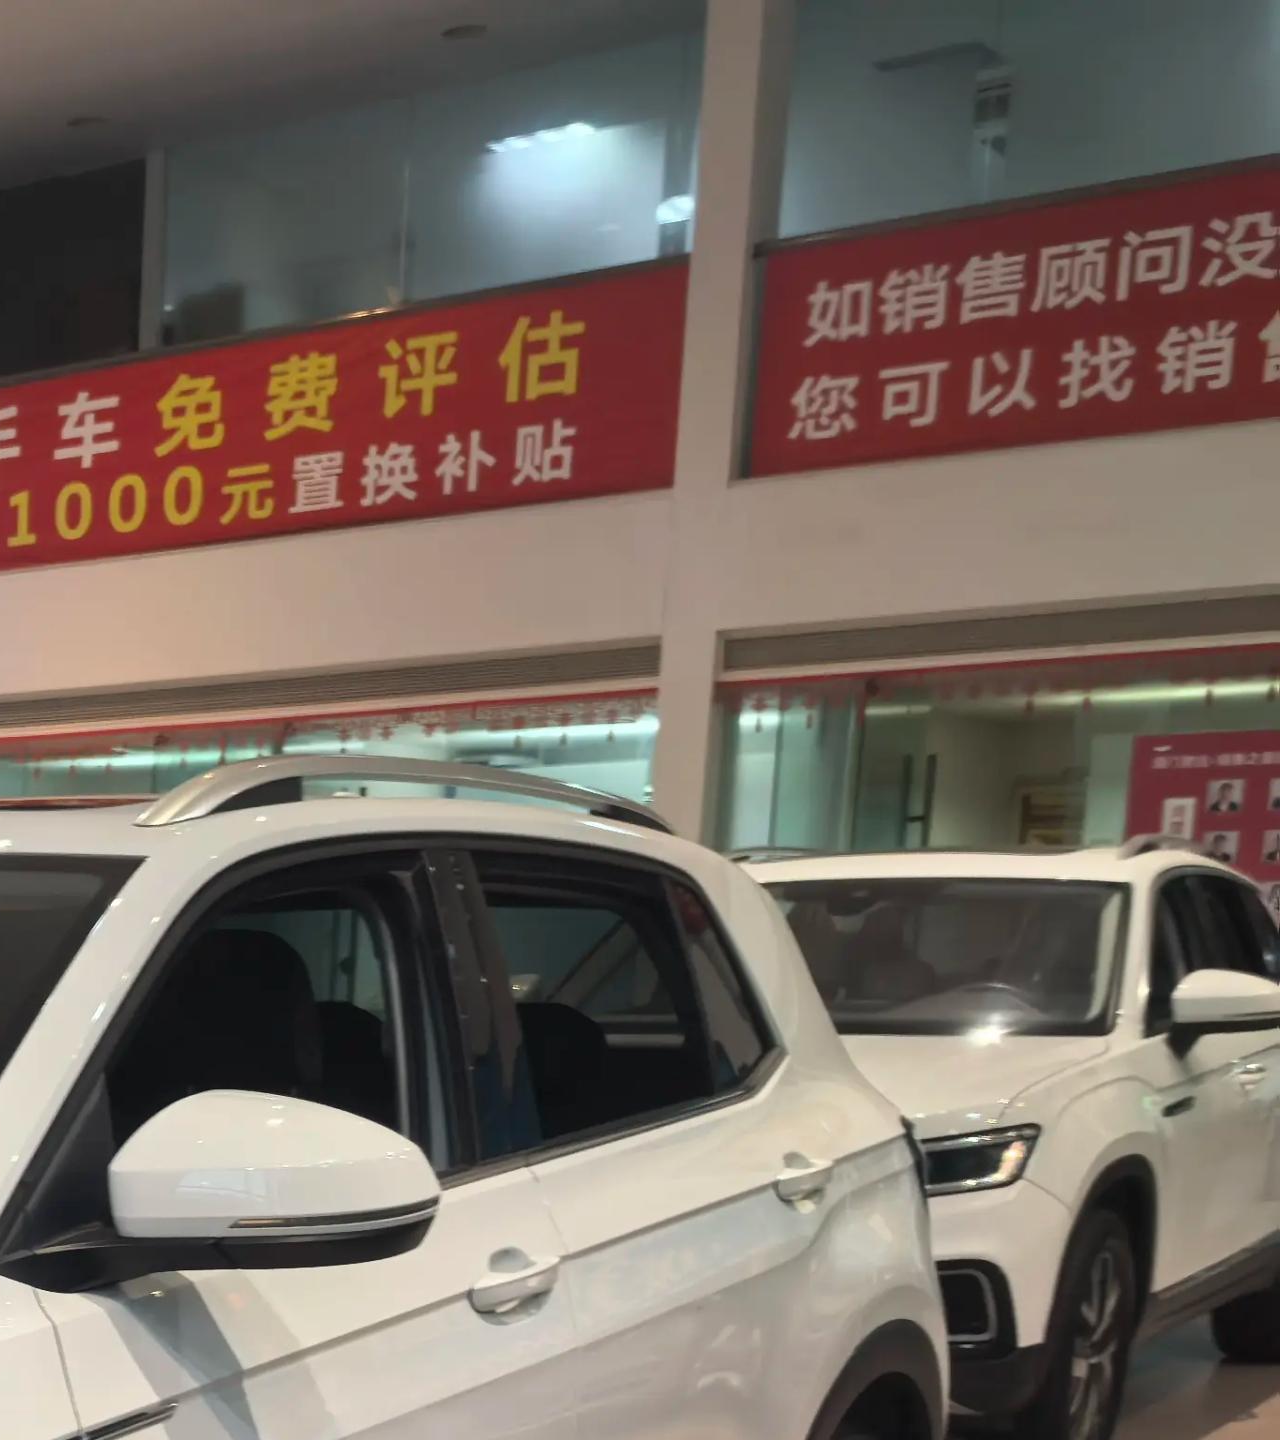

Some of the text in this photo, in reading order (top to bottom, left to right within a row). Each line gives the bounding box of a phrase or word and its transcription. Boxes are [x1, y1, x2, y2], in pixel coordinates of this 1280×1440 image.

[803, 211, 1280, 348] 如销售顾问没
